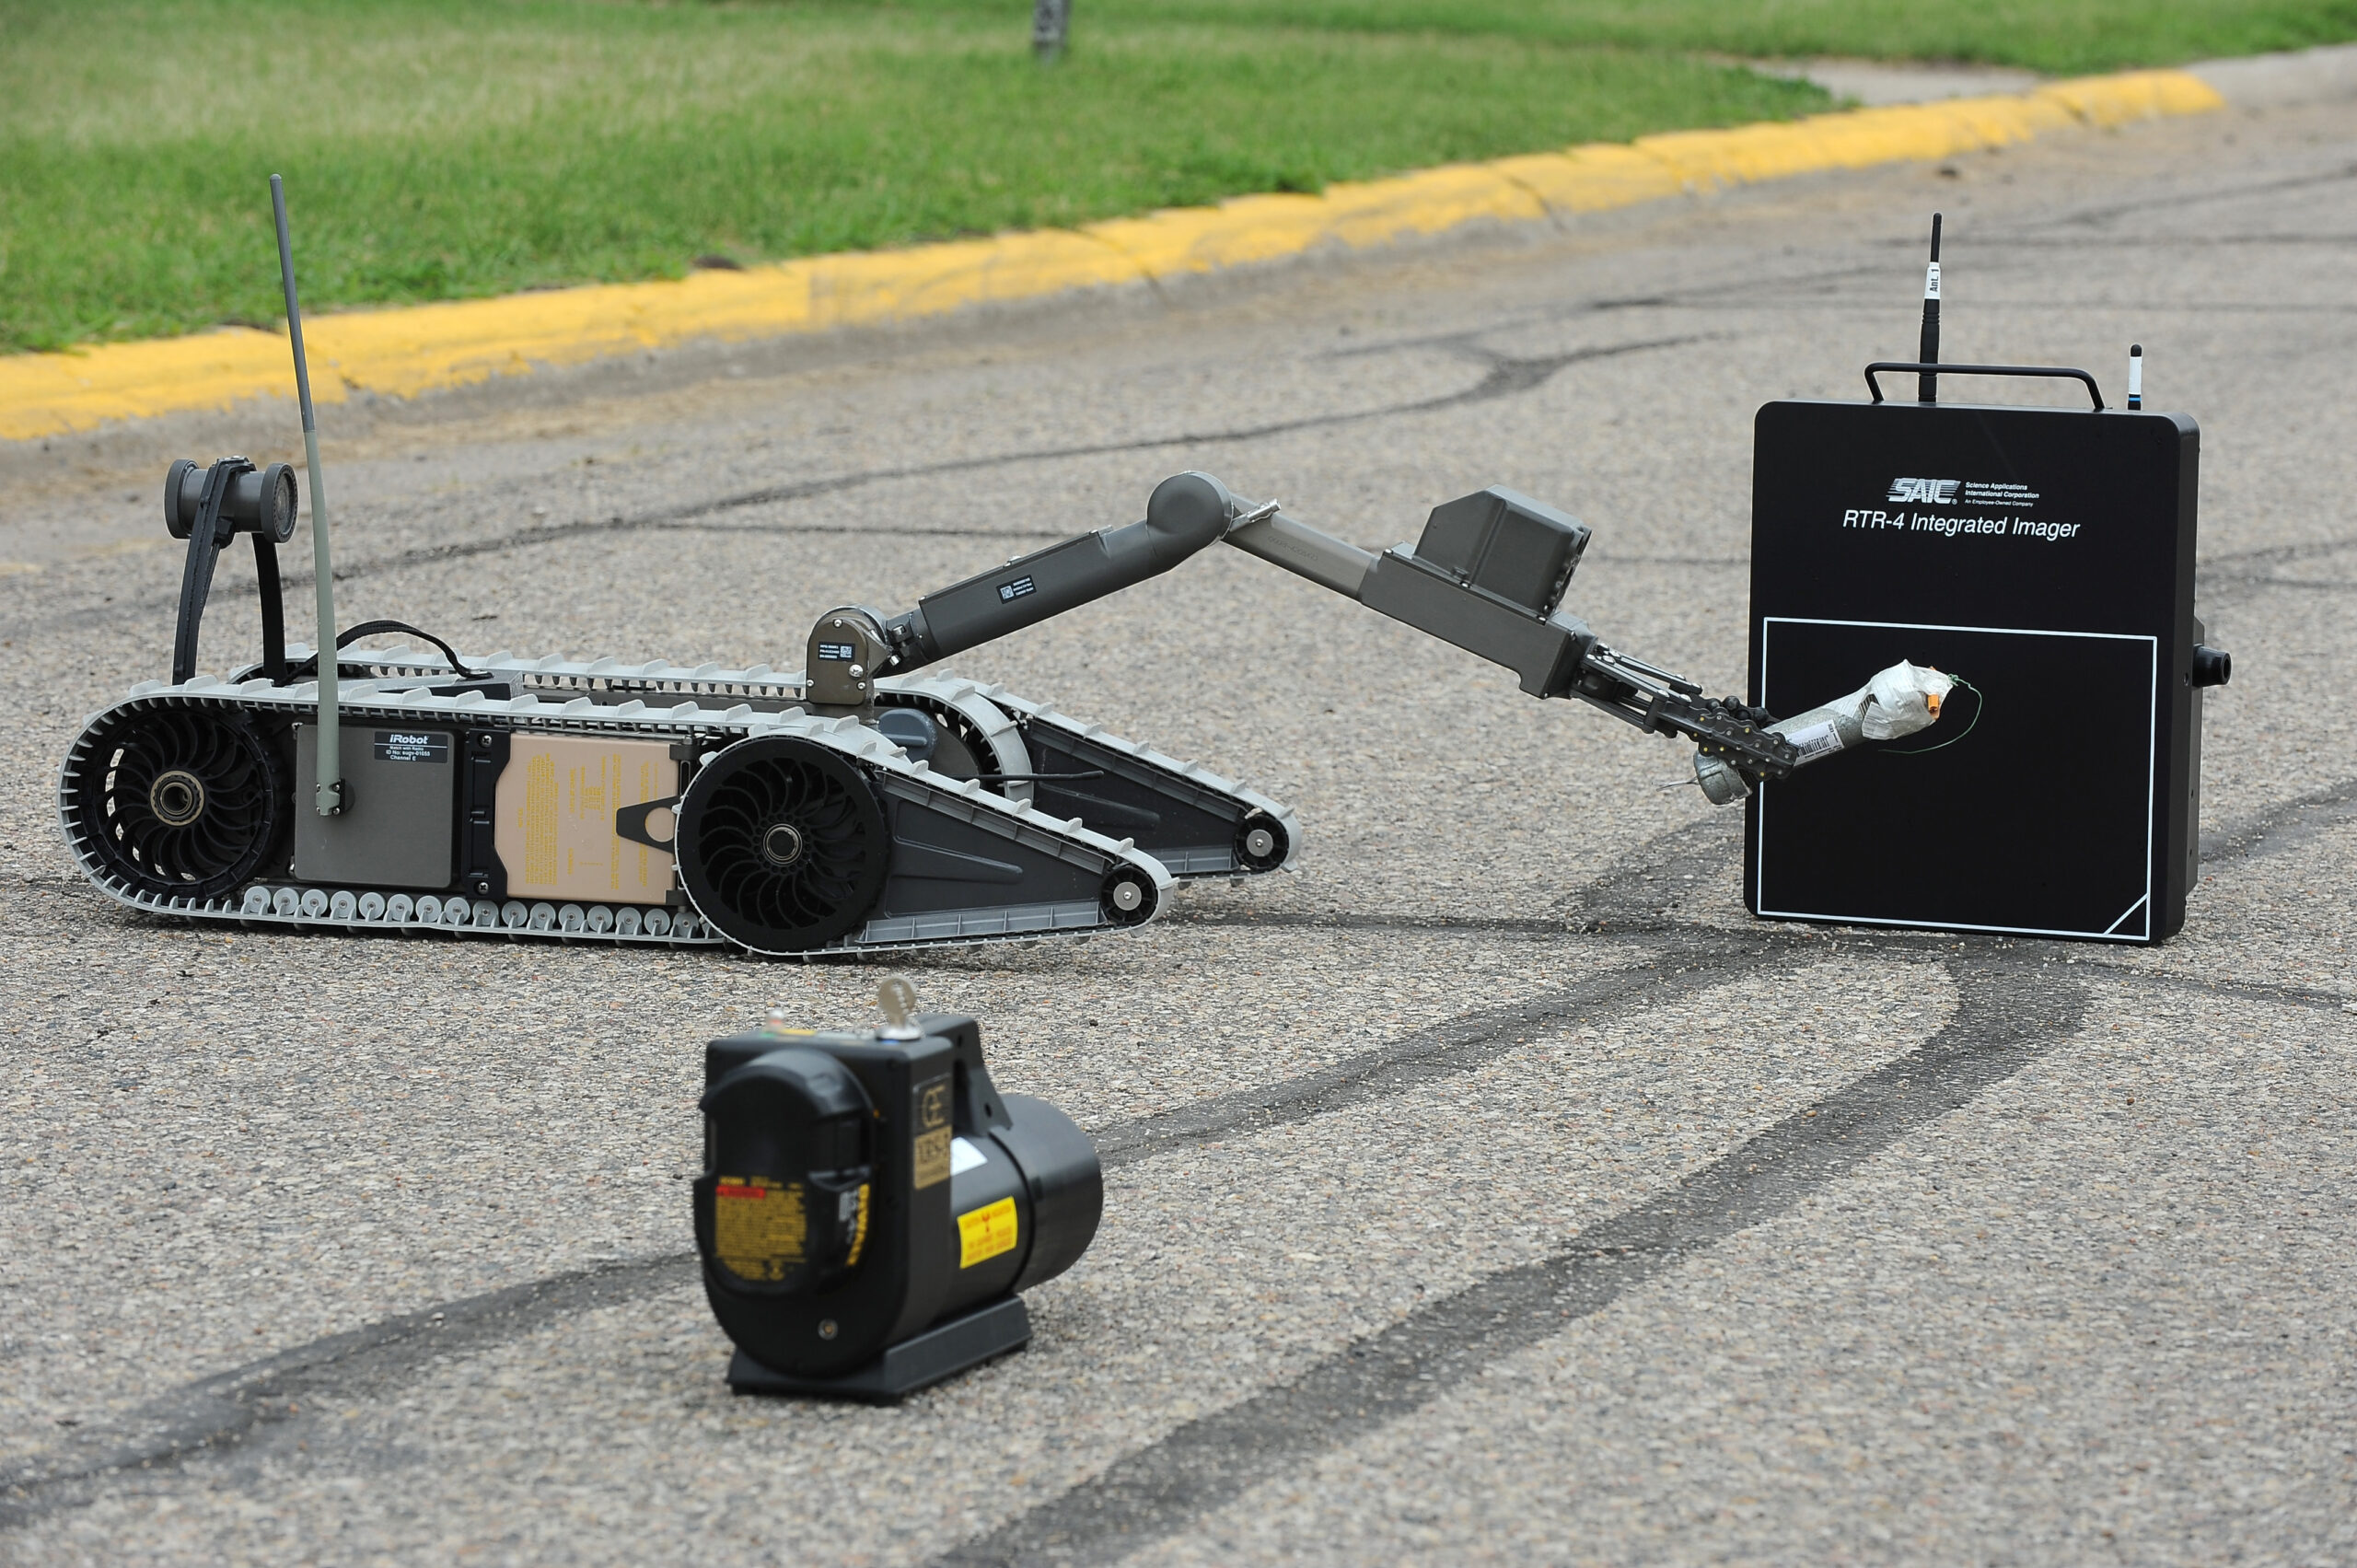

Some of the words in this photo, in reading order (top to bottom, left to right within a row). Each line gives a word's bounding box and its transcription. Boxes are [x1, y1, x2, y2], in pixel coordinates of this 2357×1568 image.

[1886, 477, 1961, 504] SAIC
[1965, 482, 1990, 490] Science
[1990, 482, 2028, 492] Applications
[1965, 490, 2003, 498] International
[2003, 491, 2040, 500] Corporation
[1842, 509, 1905, 530] RTR-4
[1910, 512, 2008, 538] Integrated
[2012, 517, 2081, 541] Imager
[389, 734, 428, 744] iRobot
